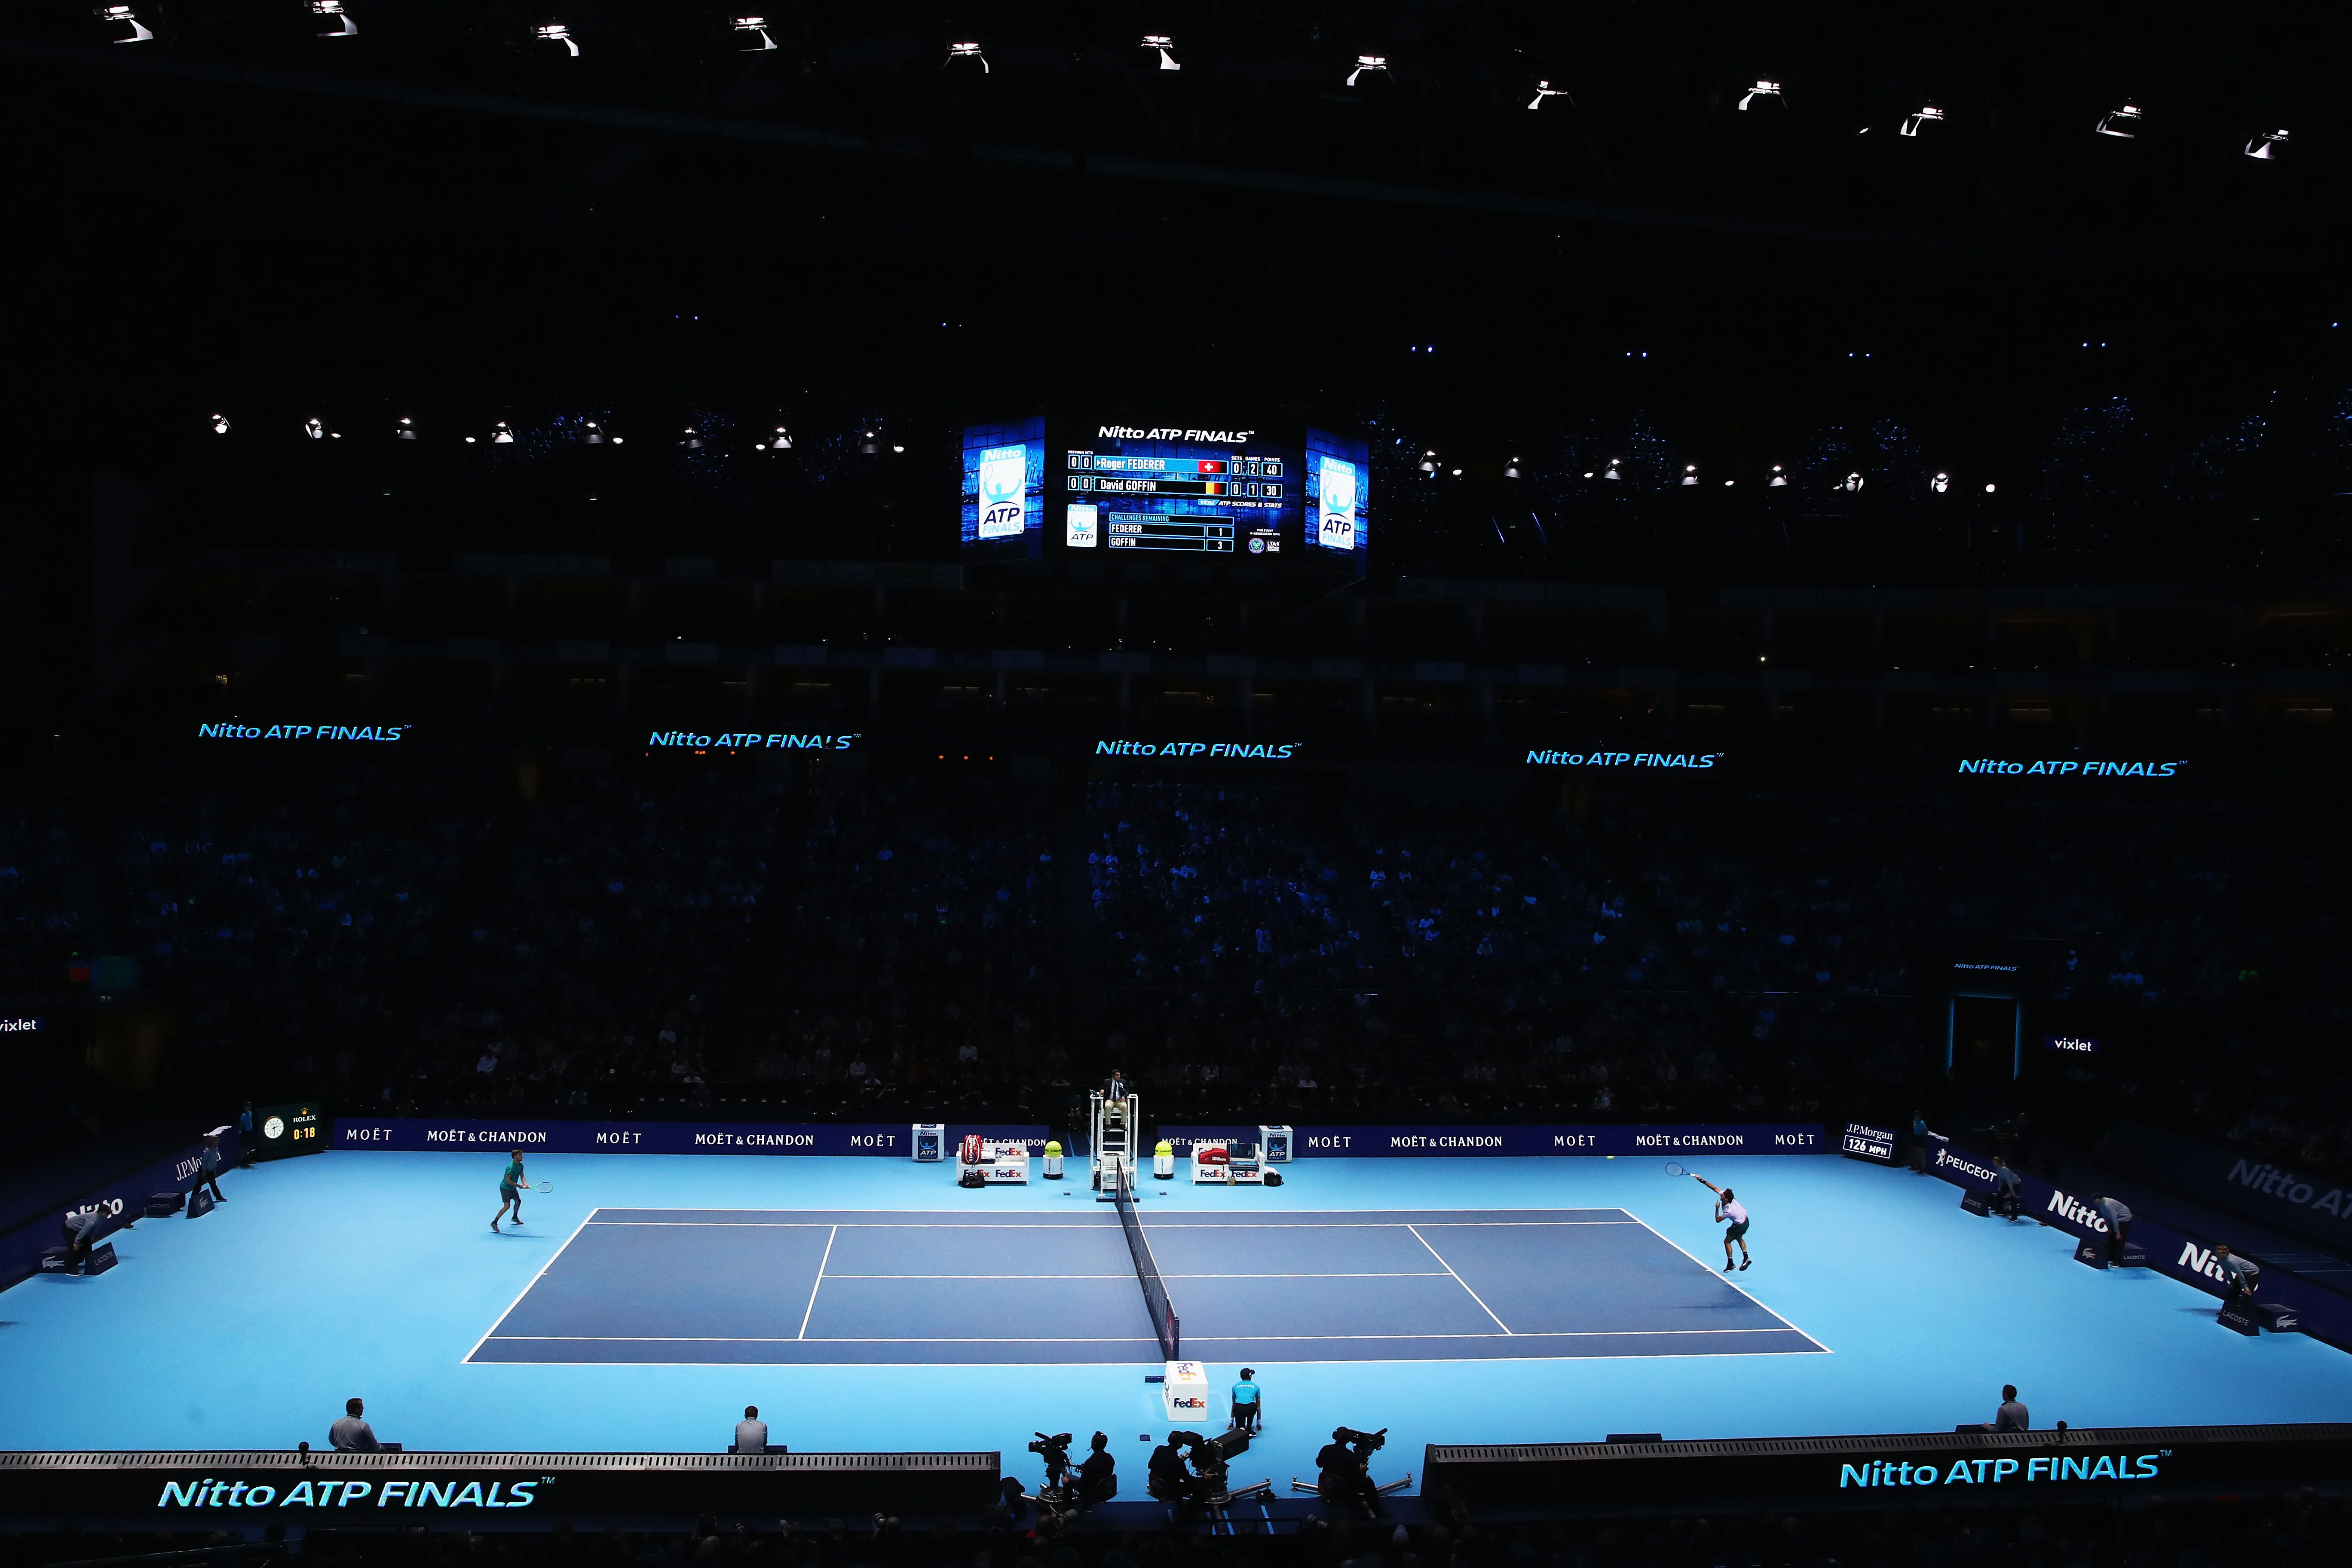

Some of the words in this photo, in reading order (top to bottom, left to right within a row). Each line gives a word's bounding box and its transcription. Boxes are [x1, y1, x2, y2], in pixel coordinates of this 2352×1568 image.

[1098, 426, 1144, 439] Nitto
[1146, 429, 1182, 440] ATP
[984, 449, 1022, 461] Nitto
[1072, 457, 1077, 467] 0
[1084, 457, 1089, 468] 0
[1101, 458, 1126, 470] Roger
[1127, 460, 1165, 470] FEDERER
[1234, 463, 1239, 473] 0
[1324, 458, 1352, 475] Nitto
[1250, 464, 1256, 474] 2
[1267, 465, 1277, 475] 40
[1071, 478, 1076, 488] 0
[1084, 478, 1089, 489] 0
[1100, 479, 1124, 491] David
[1126, 481, 1156, 491] GOFFIN
[1233, 484, 1238, 494] 0
[1251, 485, 1255, 495] 1
[1267, 486, 1276, 496] 30
[983, 508, 1020, 524] ATP
[983, 522, 1020, 534] FINALS
[1112, 525, 1142, 533] FEDERER
[1219, 528, 1222, 536] 1
[1323, 519, 1351, 535] ATP
[1111, 538, 1136, 547] GOFFIN
[1218, 541, 1222, 550] 3
[1323, 533, 1351, 546] FINALS
[199, 723, 260, 738] Nitto
[264, 725, 312, 739] ATP
[649, 731, 711, 747] Nitto
[714, 733, 762, 747] ATP
[1096, 740, 1156, 755] Nitto
[1160, 742, 1206, 756] ATP
[1526, 750, 1583, 765] Nitto
[1586, 752, 1630, 766] ATP
[1959, 759, 2023, 774] Nitto
[2027, 761, 2078, 774] ATP
[2055, 1038, 2092, 1051] vixlet
[293, 1127, 315, 1140] 0:18
[346, 1128, 392, 1141] MOËT
[427, 1129, 466, 1142] MOËT
[468, 1133, 476, 1142] &
[479, 1131, 547, 1143] CHANDON
[597, 1131, 642, 1144] MOËT
[695, 1133, 733, 1145] MOËT
[736, 1136, 744, 1145] &
[747, 1134, 814, 1146] CHANDON
[1636, 1134, 1671, 1146] MOËT
[1673, 1138, 1680, 1146] &
[1683, 1135, 1744, 1146] CHANDON
[1775, 1132, 1815, 1145] MOËT
[851, 1134, 895, 1147] MOËT
[1308, 1135, 1351, 1148] MOËT
[1390, 1135, 1427, 1147] MOËT
[1429, 1138, 1436, 1147] &
[1439, 1136, 1502, 1147] CHANDON
[1554, 1134, 1595, 1147] MOËT
[1849, 1138, 1866, 1151] 126
[1869, 1145, 1887, 1155] MPH
[1945, 1155, 1997, 1182] PEUGEOT
[2227, 1159, 2314, 1204] Nitto
[1964, 1197, 1981, 1208] LACOSTE
[2047, 1190, 2108, 1233] Nitto
[95, 1251, 114, 1265] LACOSTE
[2223, 1310, 2249, 1326] LACOSTE
[1174, 1398, 1205, 1408] FedEx
[1840, 1460, 1939, 1488] Nitto
[1944, 1458, 2019, 1485] ATP
[158, 1479, 276, 1507] Nitto
[279, 1481, 372, 1507] ATP
